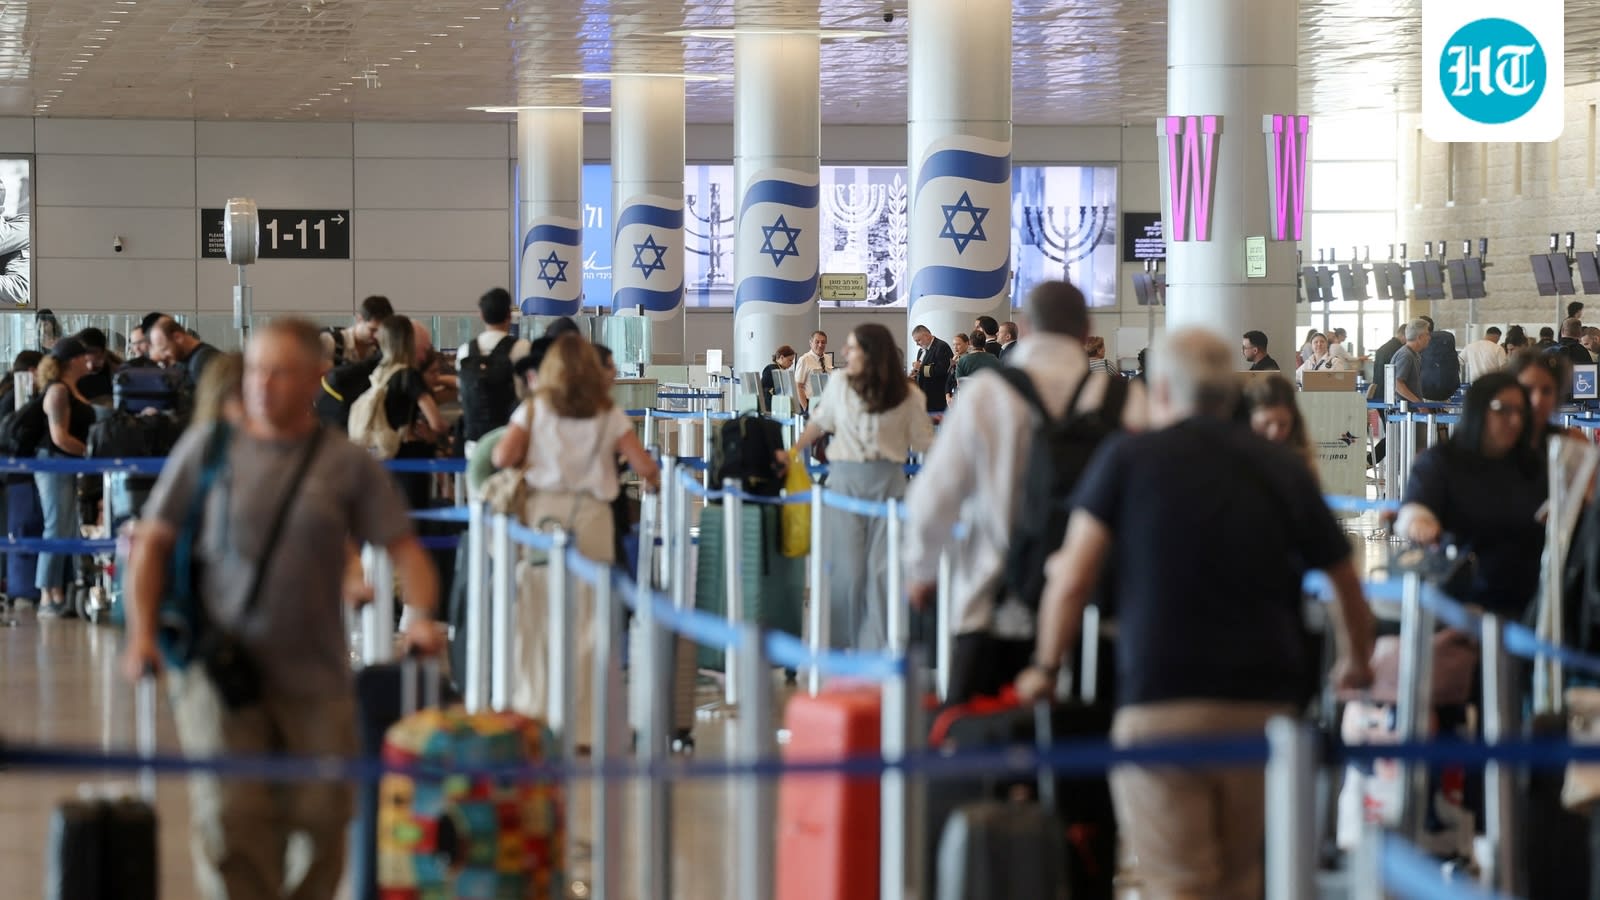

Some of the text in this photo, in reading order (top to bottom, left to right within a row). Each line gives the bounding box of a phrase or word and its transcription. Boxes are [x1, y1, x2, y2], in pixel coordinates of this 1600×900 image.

[266, 218, 326, 250] 1-11
[1164, 115, 1219, 241] W
[1271, 115, 1309, 241] W
